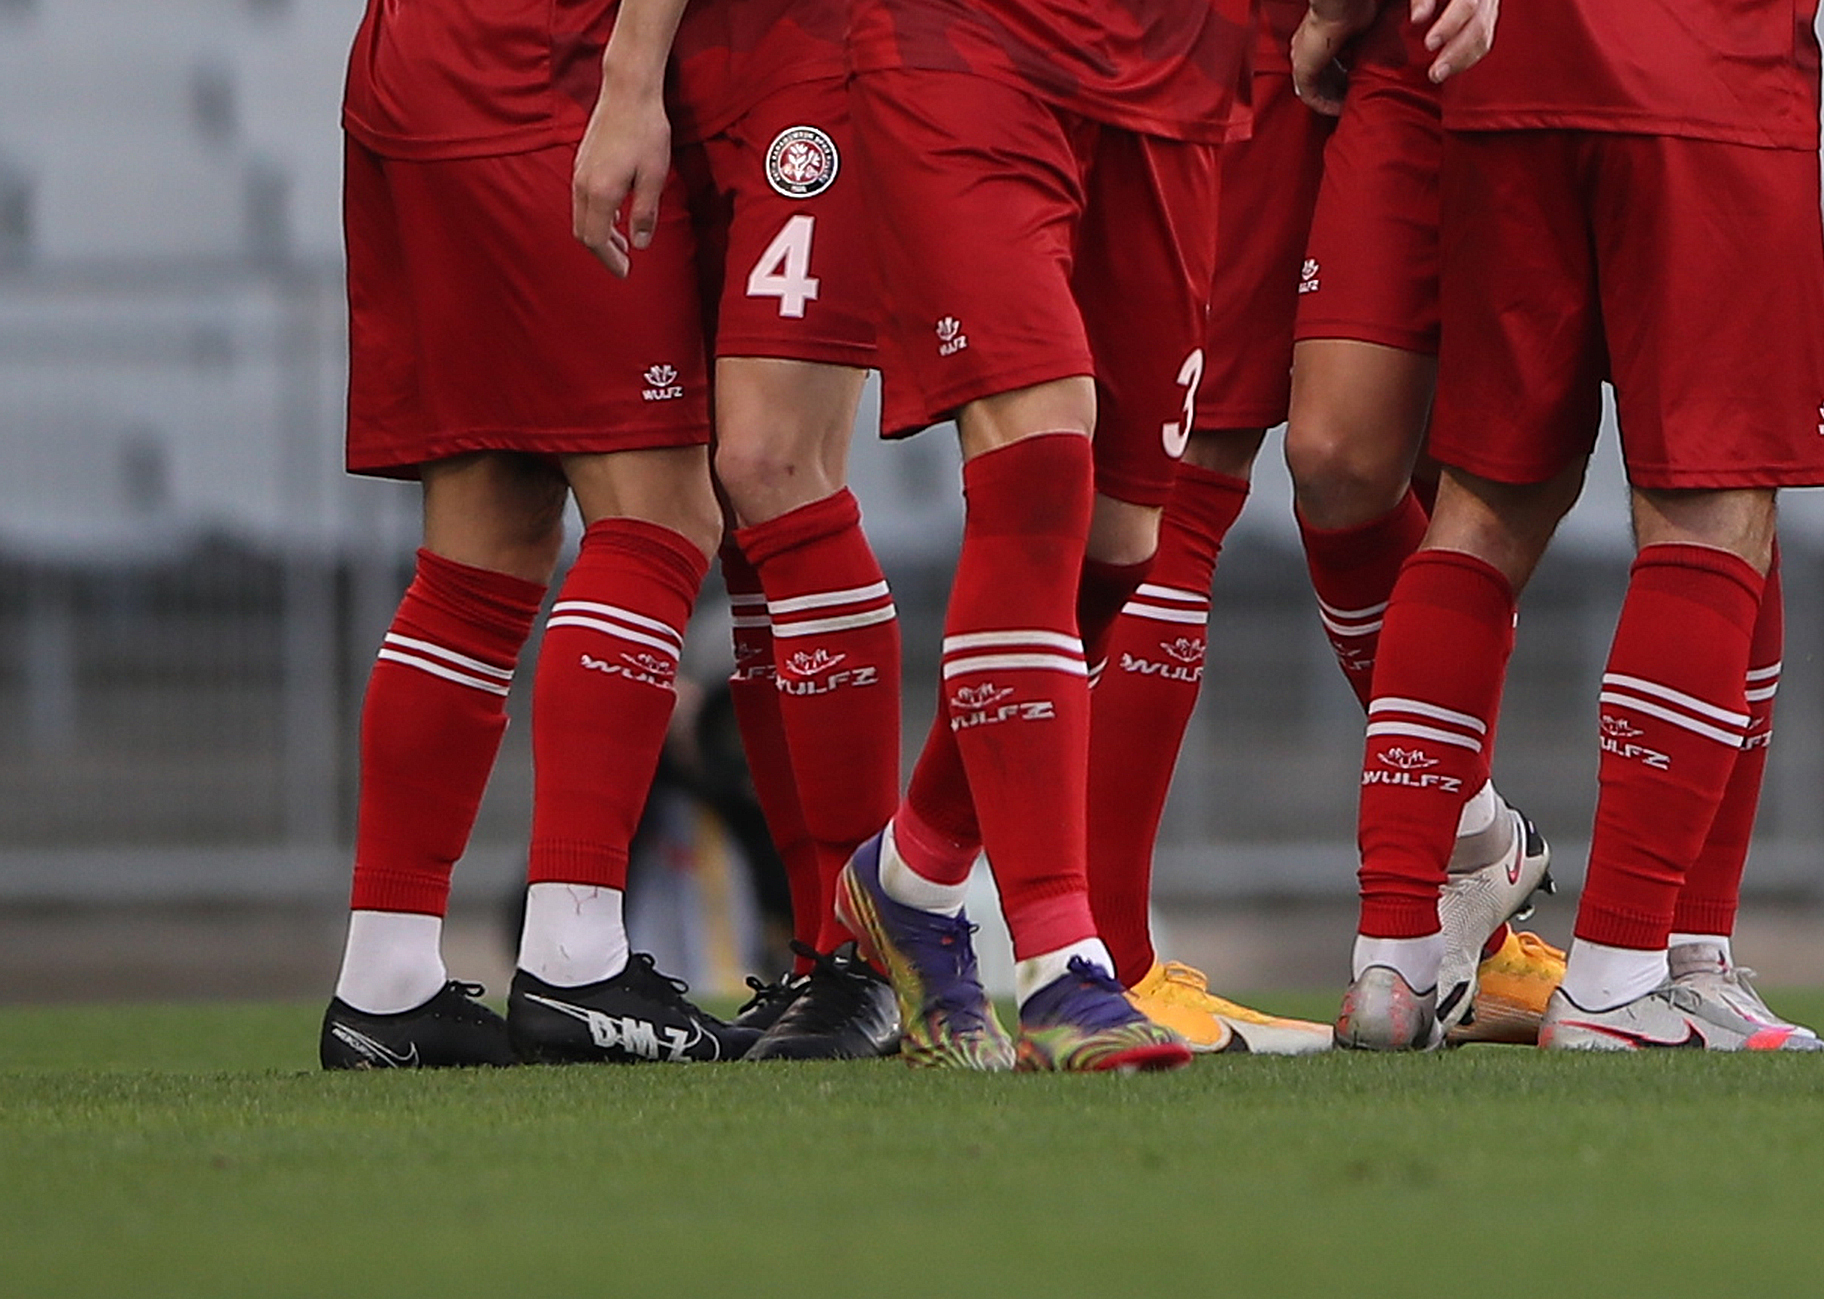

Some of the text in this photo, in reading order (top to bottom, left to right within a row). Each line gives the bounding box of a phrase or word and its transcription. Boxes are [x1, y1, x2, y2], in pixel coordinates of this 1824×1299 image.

[746, 214, 820, 318] 4
[1162, 347, 1204, 458] 3
[1362, 771, 1462, 793] WULFZ
